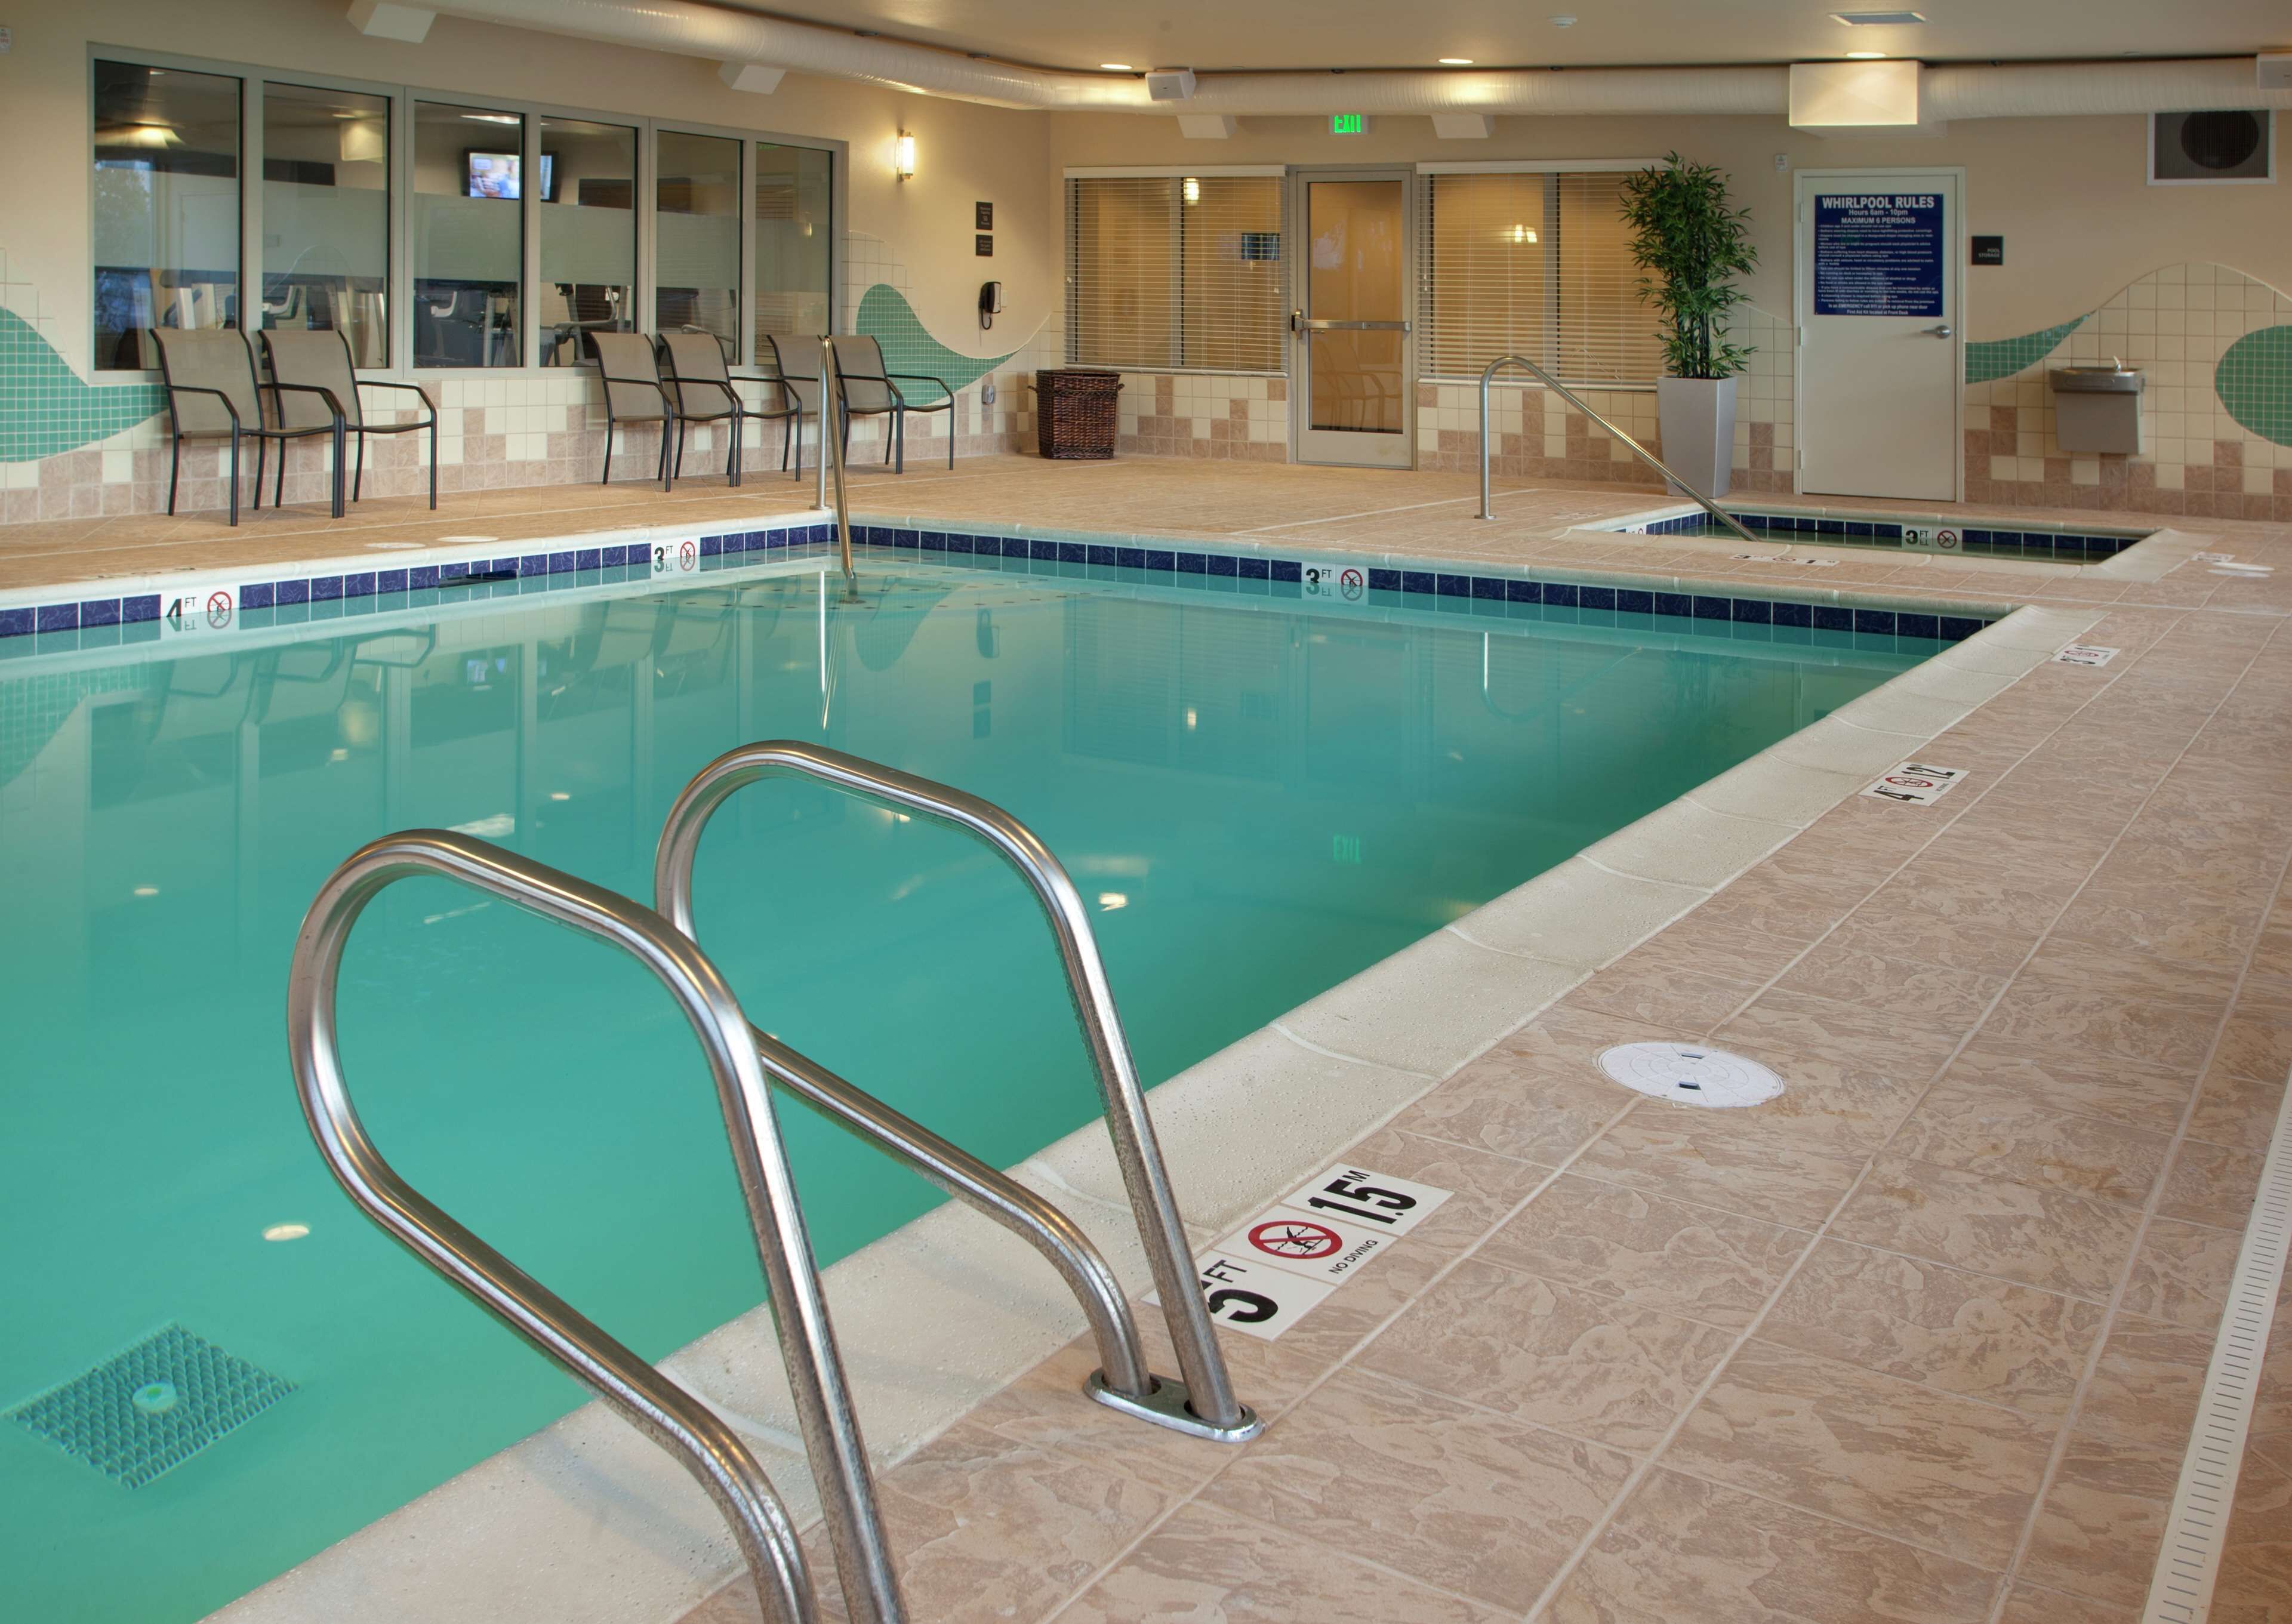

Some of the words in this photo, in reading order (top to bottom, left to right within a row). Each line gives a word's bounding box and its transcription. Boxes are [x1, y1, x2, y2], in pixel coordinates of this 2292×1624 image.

[1334, 114, 1361, 133] EXIT
[1822, 196, 1891, 209] WHIRLPOOL
[1895, 196, 1934, 209] RULES
[654, 546, 664, 561] 3
[666, 545, 673, 554] FT
[1306, 568, 1320, 584] 3
[1321, 568, 1332, 578] FT
[185, 596, 197, 608] FT
[1872, 789, 1925, 802] 4
[1341, 1169, 1371, 1182] M
[1307, 1178, 1417, 1225] 1.5
[1328, 1262, 1349, 1274] NO
[1343, 1239, 1379, 1262] DIVING
[1202, 1259, 1247, 1284] FT
[1201, 1279, 1279, 1323] 5
